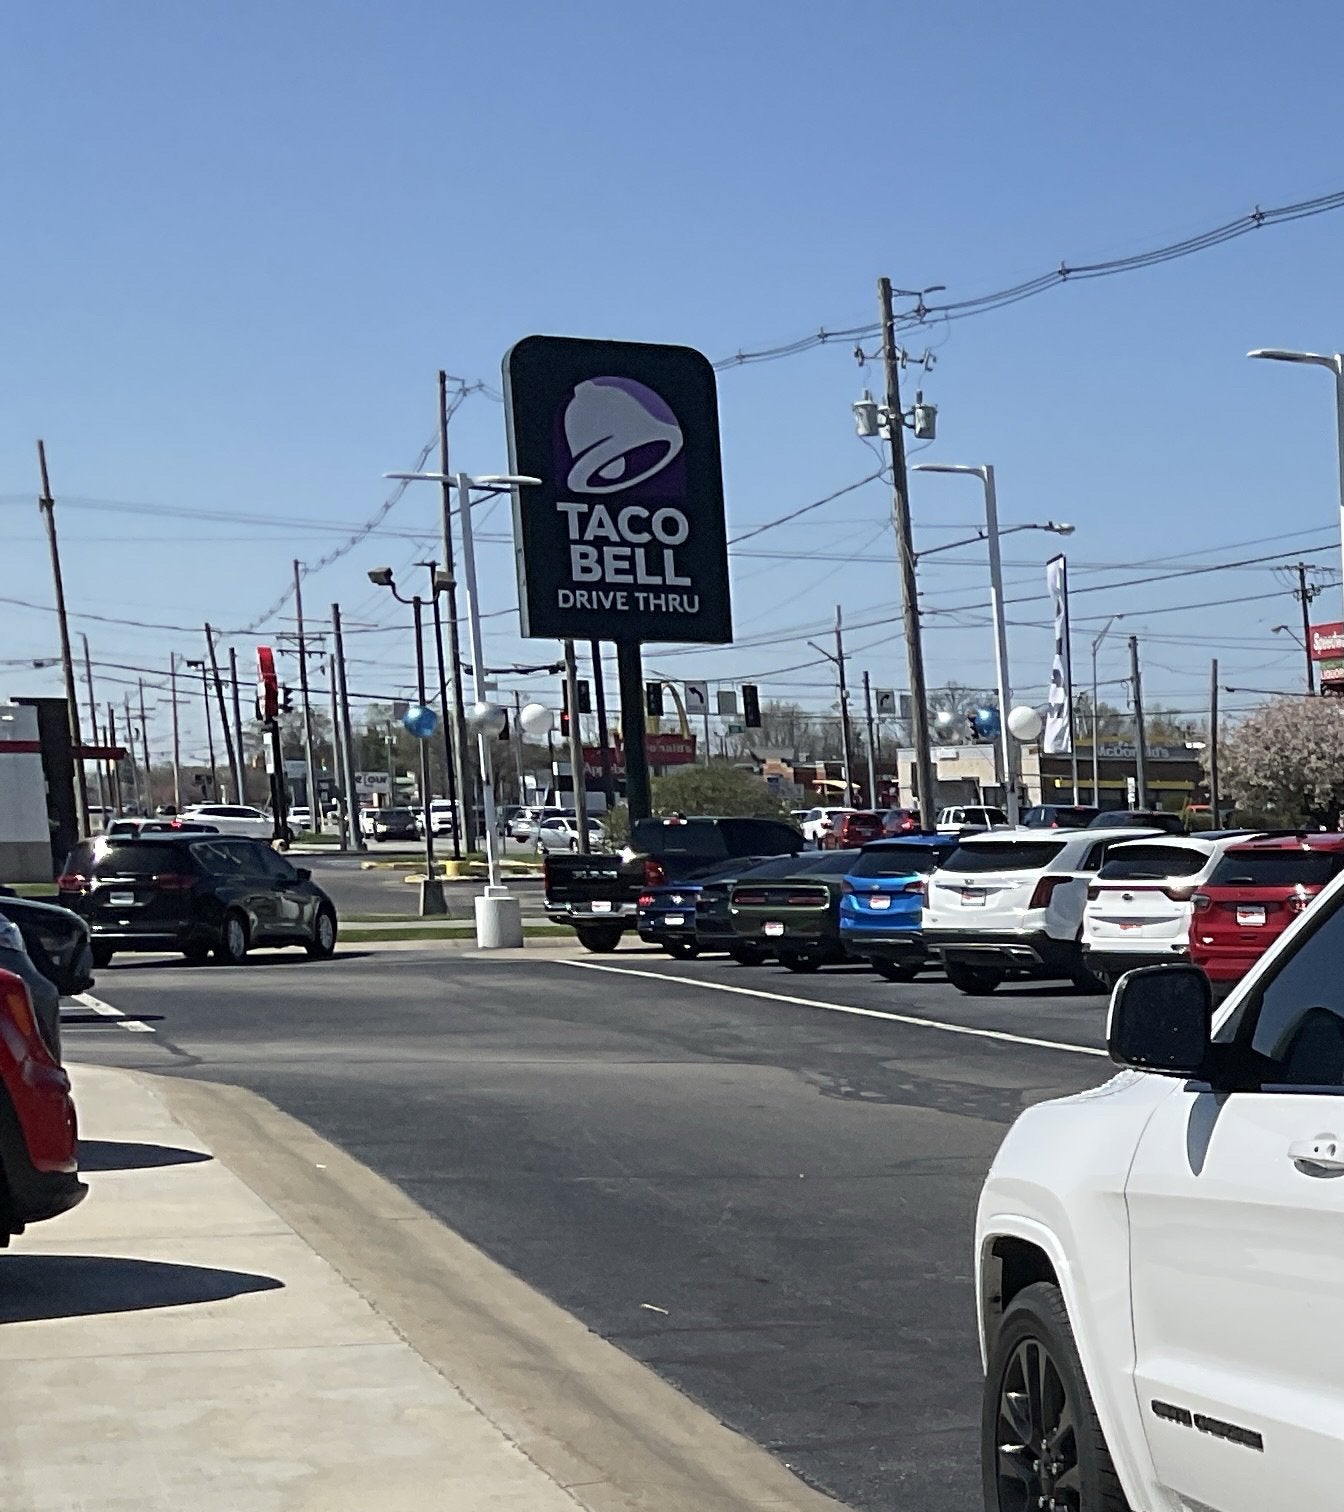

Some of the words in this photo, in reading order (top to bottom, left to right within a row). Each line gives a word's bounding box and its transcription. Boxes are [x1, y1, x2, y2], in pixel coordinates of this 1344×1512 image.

[556, 502, 689, 545] TACO
[570, 544, 692, 586] BELL
[557, 589, 630, 610] DRIVE
[634, 592, 700, 613] THRU
